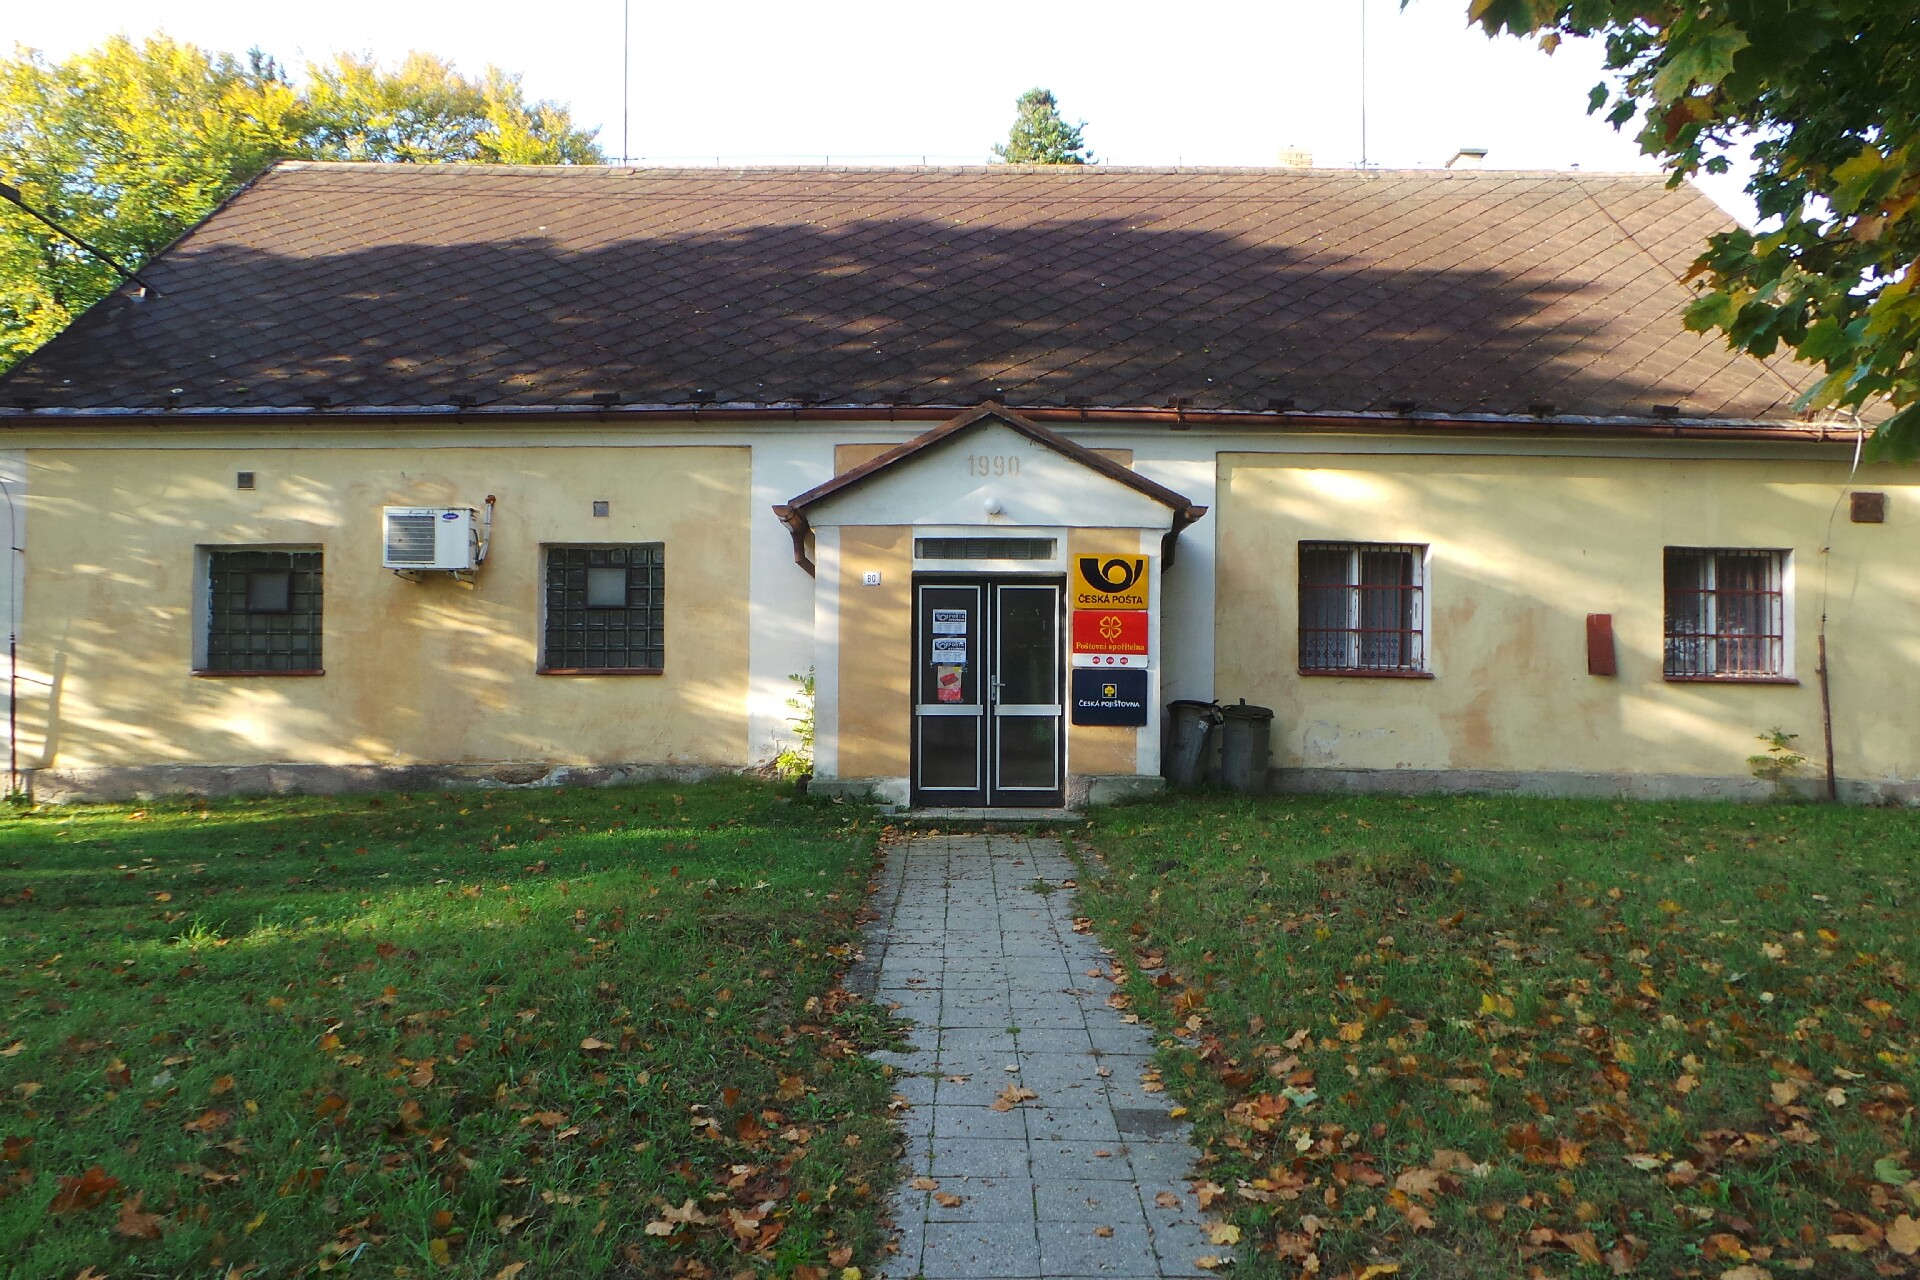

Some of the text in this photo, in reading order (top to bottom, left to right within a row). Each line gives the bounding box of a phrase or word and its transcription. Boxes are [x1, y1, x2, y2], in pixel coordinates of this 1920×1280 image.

[968, 454, 1020, 476] 1990
[1078, 594, 1143, 604] ČESKÁ POŠTA
[1108, 643, 1145, 651] spořitelna
[1078, 699, 1140, 708] ČESKÁ POJIŠŤOVNA
